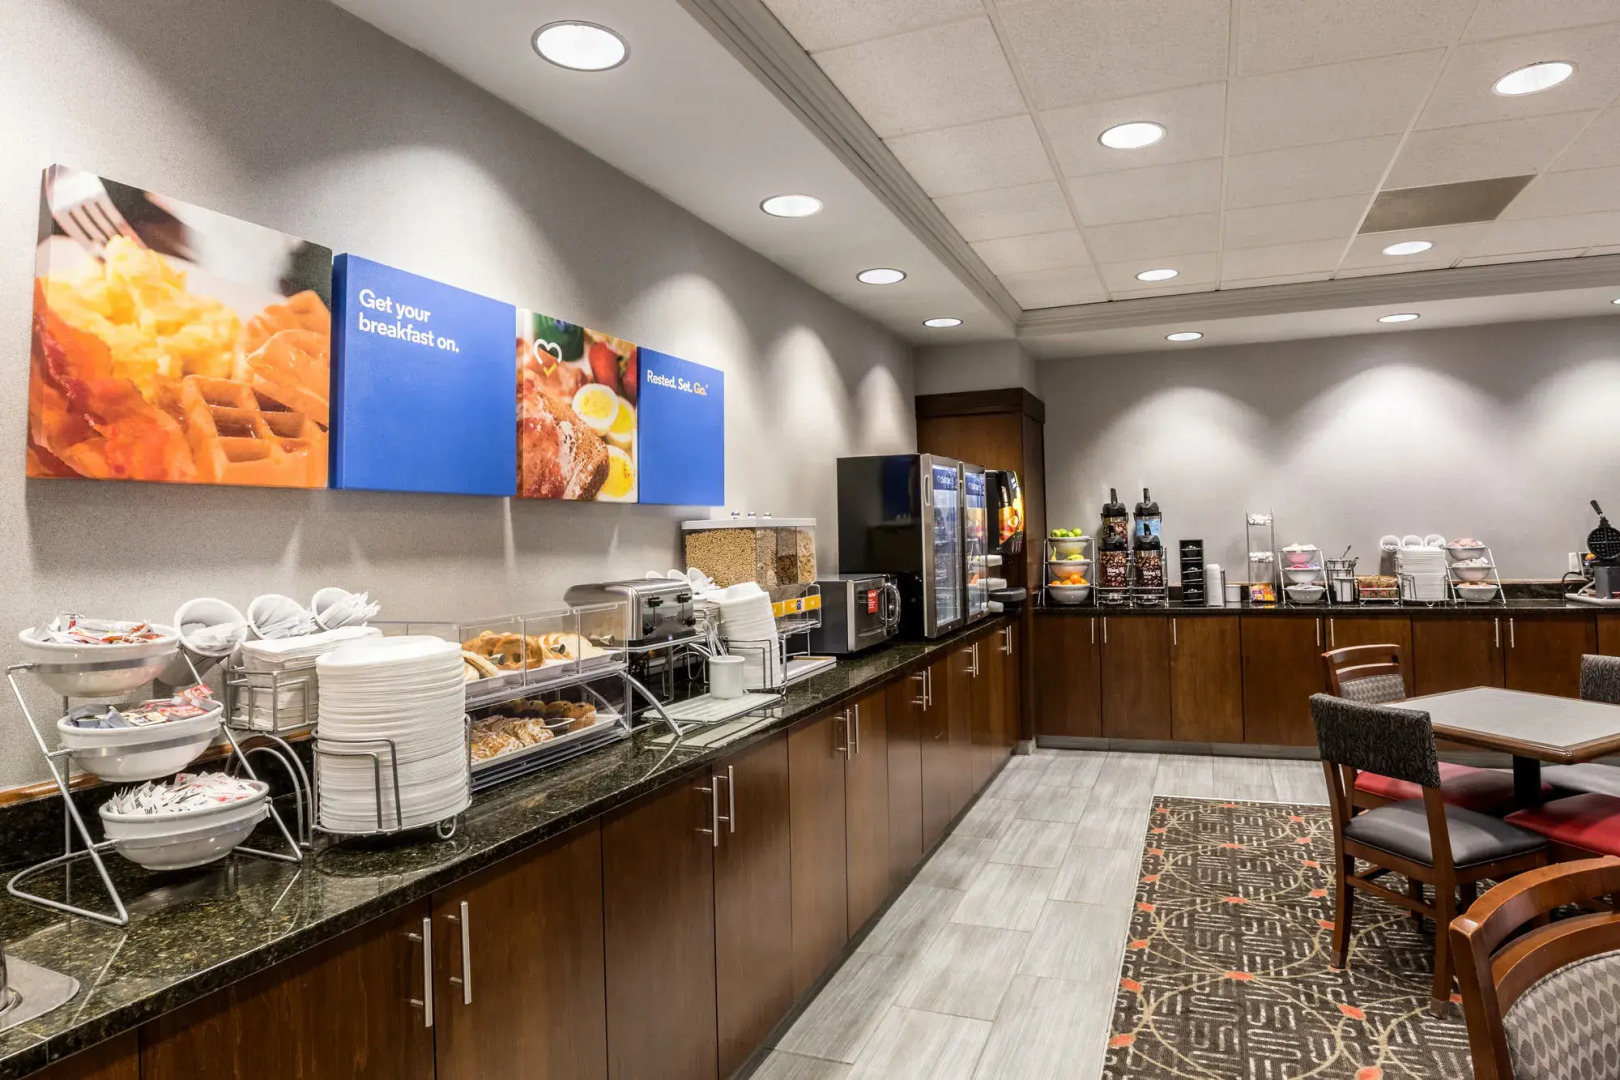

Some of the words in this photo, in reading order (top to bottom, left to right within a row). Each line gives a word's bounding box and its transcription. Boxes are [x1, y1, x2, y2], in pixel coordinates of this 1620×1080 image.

[359, 289, 392, 313] Get
[395, 302, 431, 323] your
[359, 312, 434, 347] breakfast
[437, 336, 460, 353] on.
[647, 369, 677, 389] Rested.
[678, 377, 693, 393] Set.
